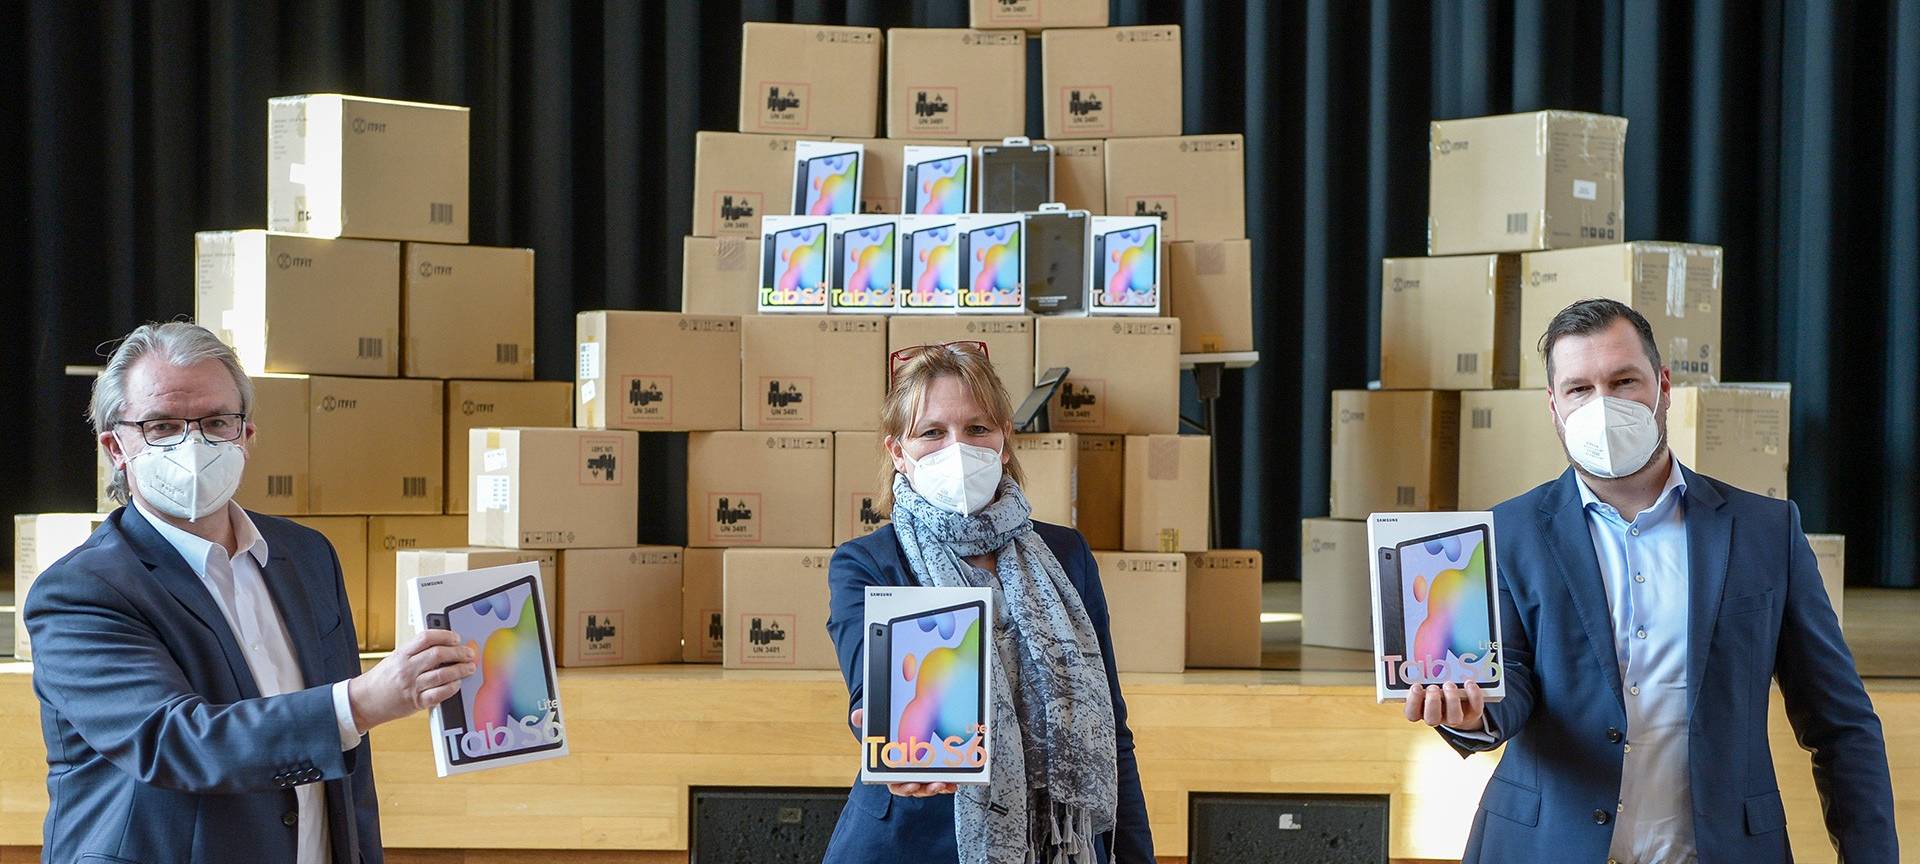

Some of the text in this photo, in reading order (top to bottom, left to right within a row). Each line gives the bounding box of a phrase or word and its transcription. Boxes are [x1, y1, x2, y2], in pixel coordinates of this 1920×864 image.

[292, 258, 312, 268] ITFIT
[433, 266, 453, 276] ITFIT
[761, 287, 799, 305] Tab
[831, 288, 869, 306] Tab
[900, 288, 937, 306] Tab
[957, 288, 996, 306] Tab
[337, 399, 357, 409] ITFIT
[476, 403, 495, 413] ITFIT
[398, 538, 416, 547] ITFIT
[1478, 640, 1499, 650] Lite
[1381, 652, 1501, 686] Tab S6
[537, 699, 558, 711] Lite
[965, 722, 987, 734] Lite
[443, 709, 564, 761] Tab S6
[864, 735, 988, 769] Tab S6
